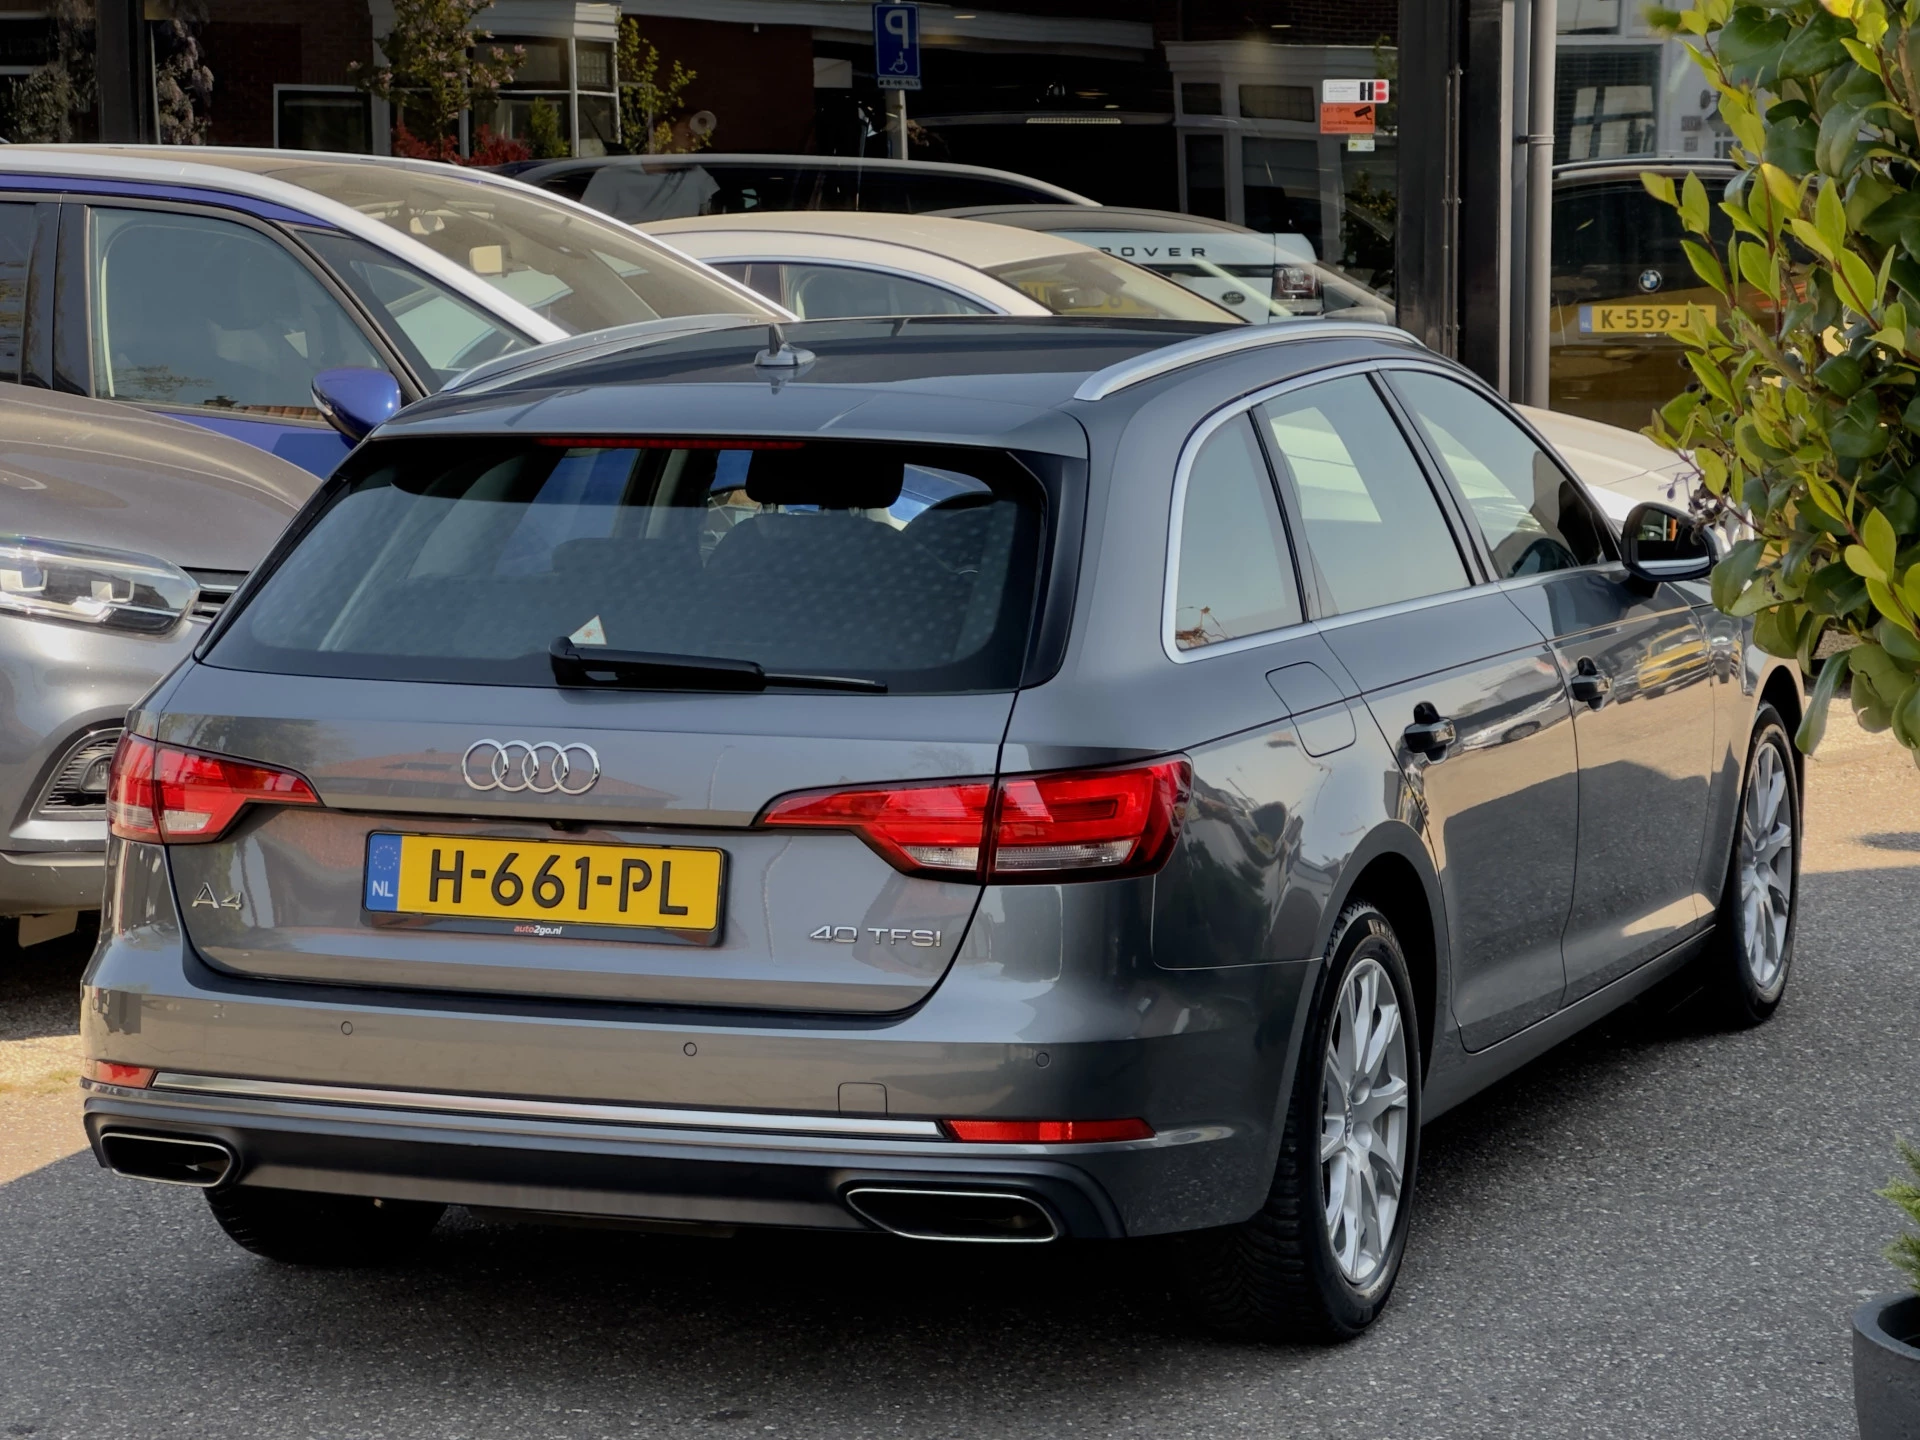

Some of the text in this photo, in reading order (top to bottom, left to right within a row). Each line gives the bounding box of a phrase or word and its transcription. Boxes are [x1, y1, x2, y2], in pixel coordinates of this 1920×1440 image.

[1601, 309, 1706, 329] K-559-J
[372, 880, 394, 897] NL
[428, 849, 689, 915] H-661-PL
[191, 881, 243, 911] A4
[513, 924, 563, 936] auto2go.nl
[809, 925, 942, 947] 40 TFSI
